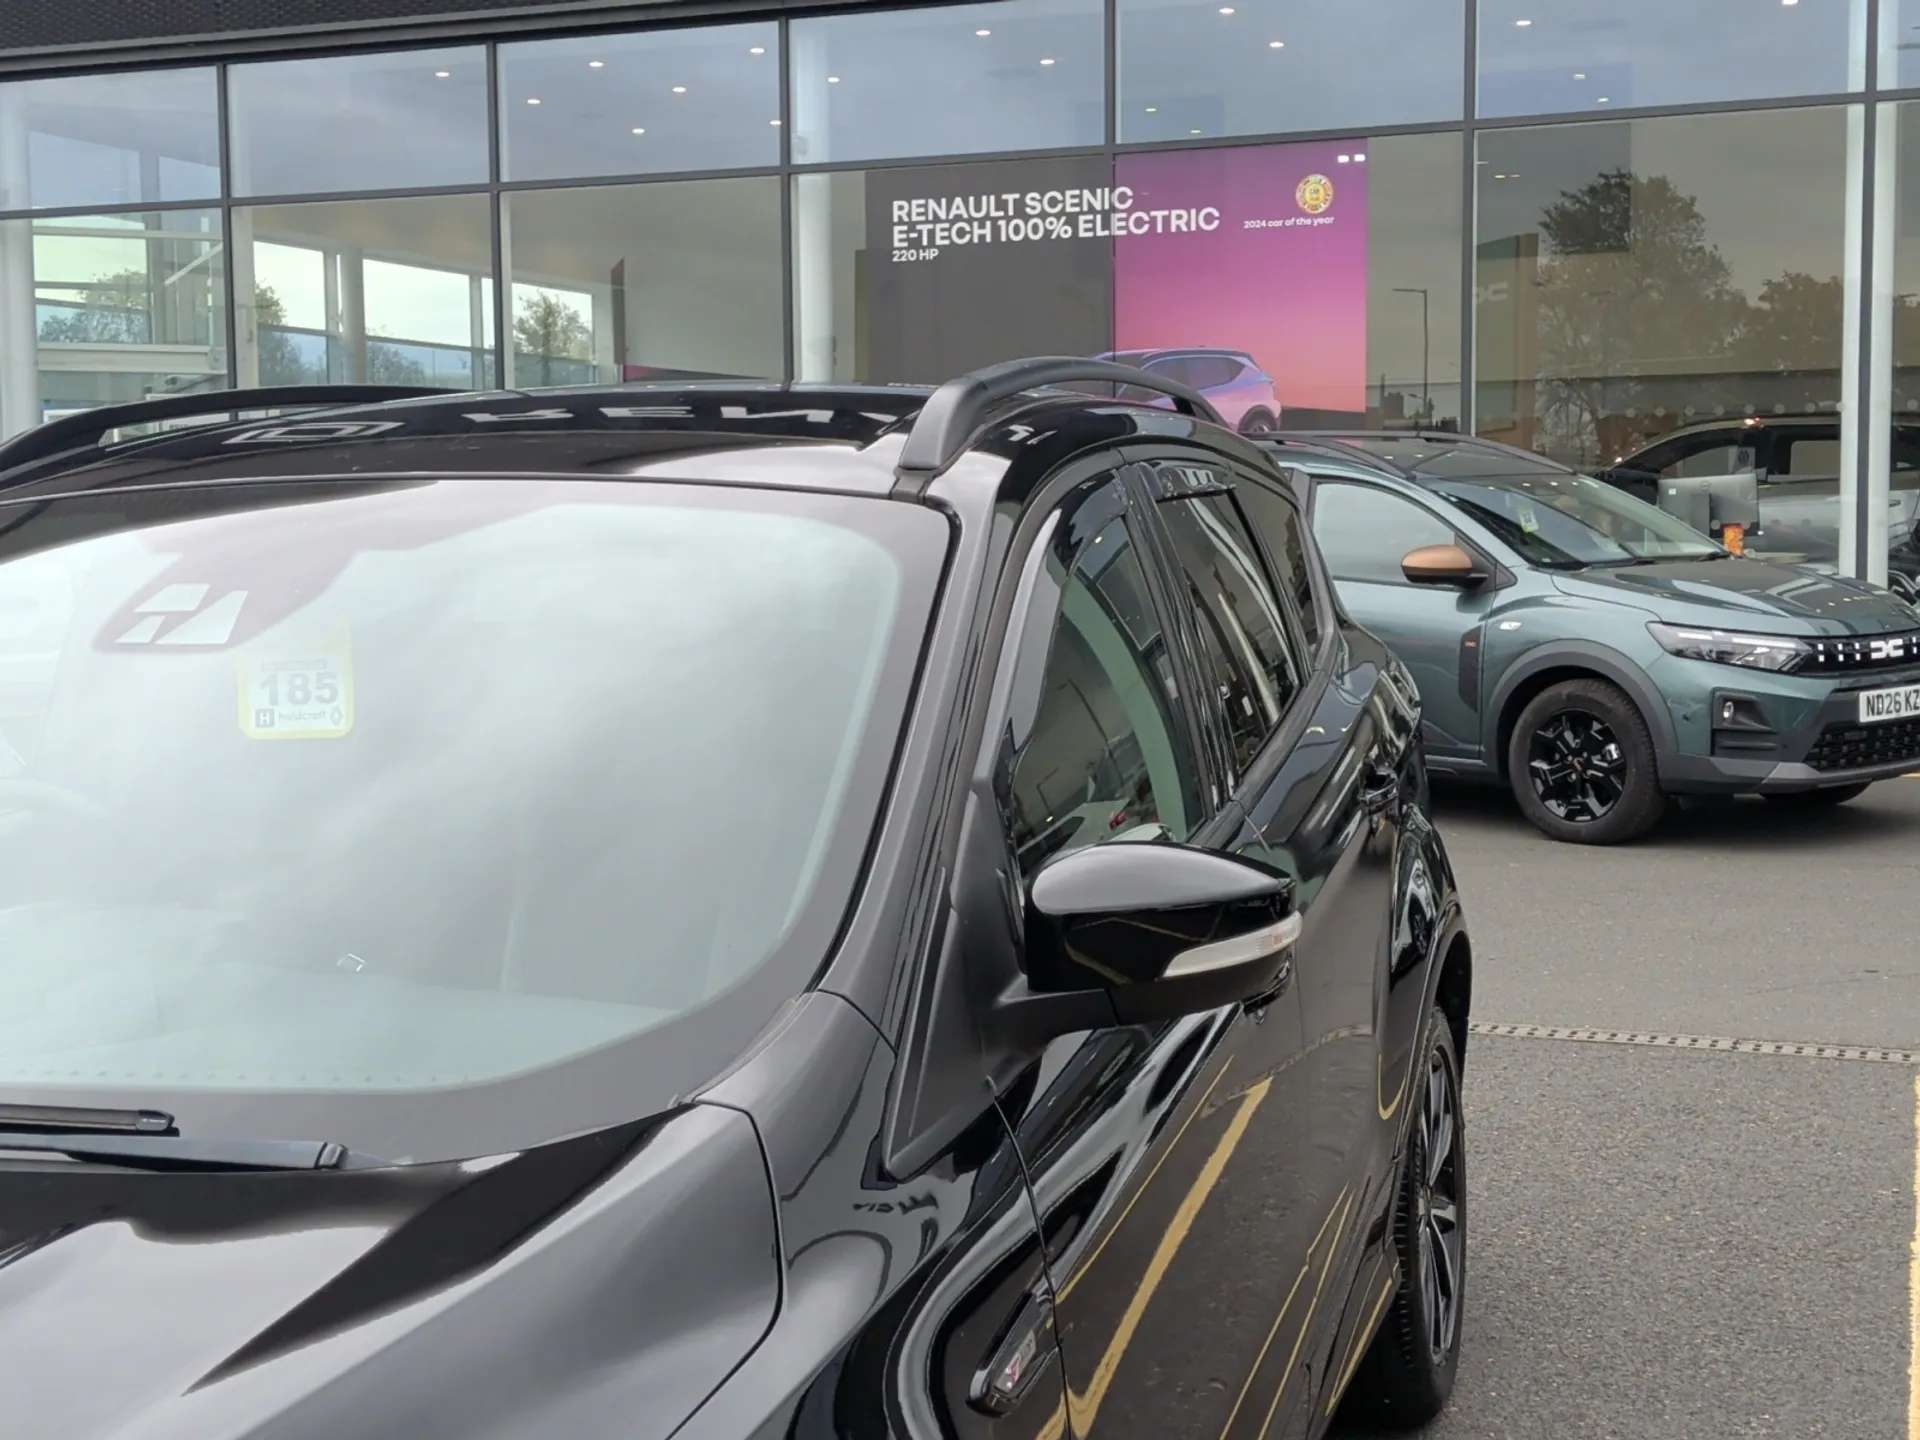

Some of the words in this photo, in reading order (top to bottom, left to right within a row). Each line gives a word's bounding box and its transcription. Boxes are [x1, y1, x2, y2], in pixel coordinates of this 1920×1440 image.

[892, 193, 1020, 223] RENAULT
[1025, 186, 1133, 216] SCENIC
[892, 220, 991, 248] E-TECH
[997, 216, 1072, 243] 100%
[1078, 207, 1221, 238] ELECTRIC
[1243, 219, 1266, 229] 2024
[1267, 219, 1283, 227] car
[1284, 217, 1295, 227] of
[1296, 217, 1311, 226] the
[1312, 216, 1335, 227] year
[892, 249, 917, 262] 220
[919, 248, 939, 261] HP
[260, 671, 339, 706] 185
[1866, 691, 1902, 717] ND26
